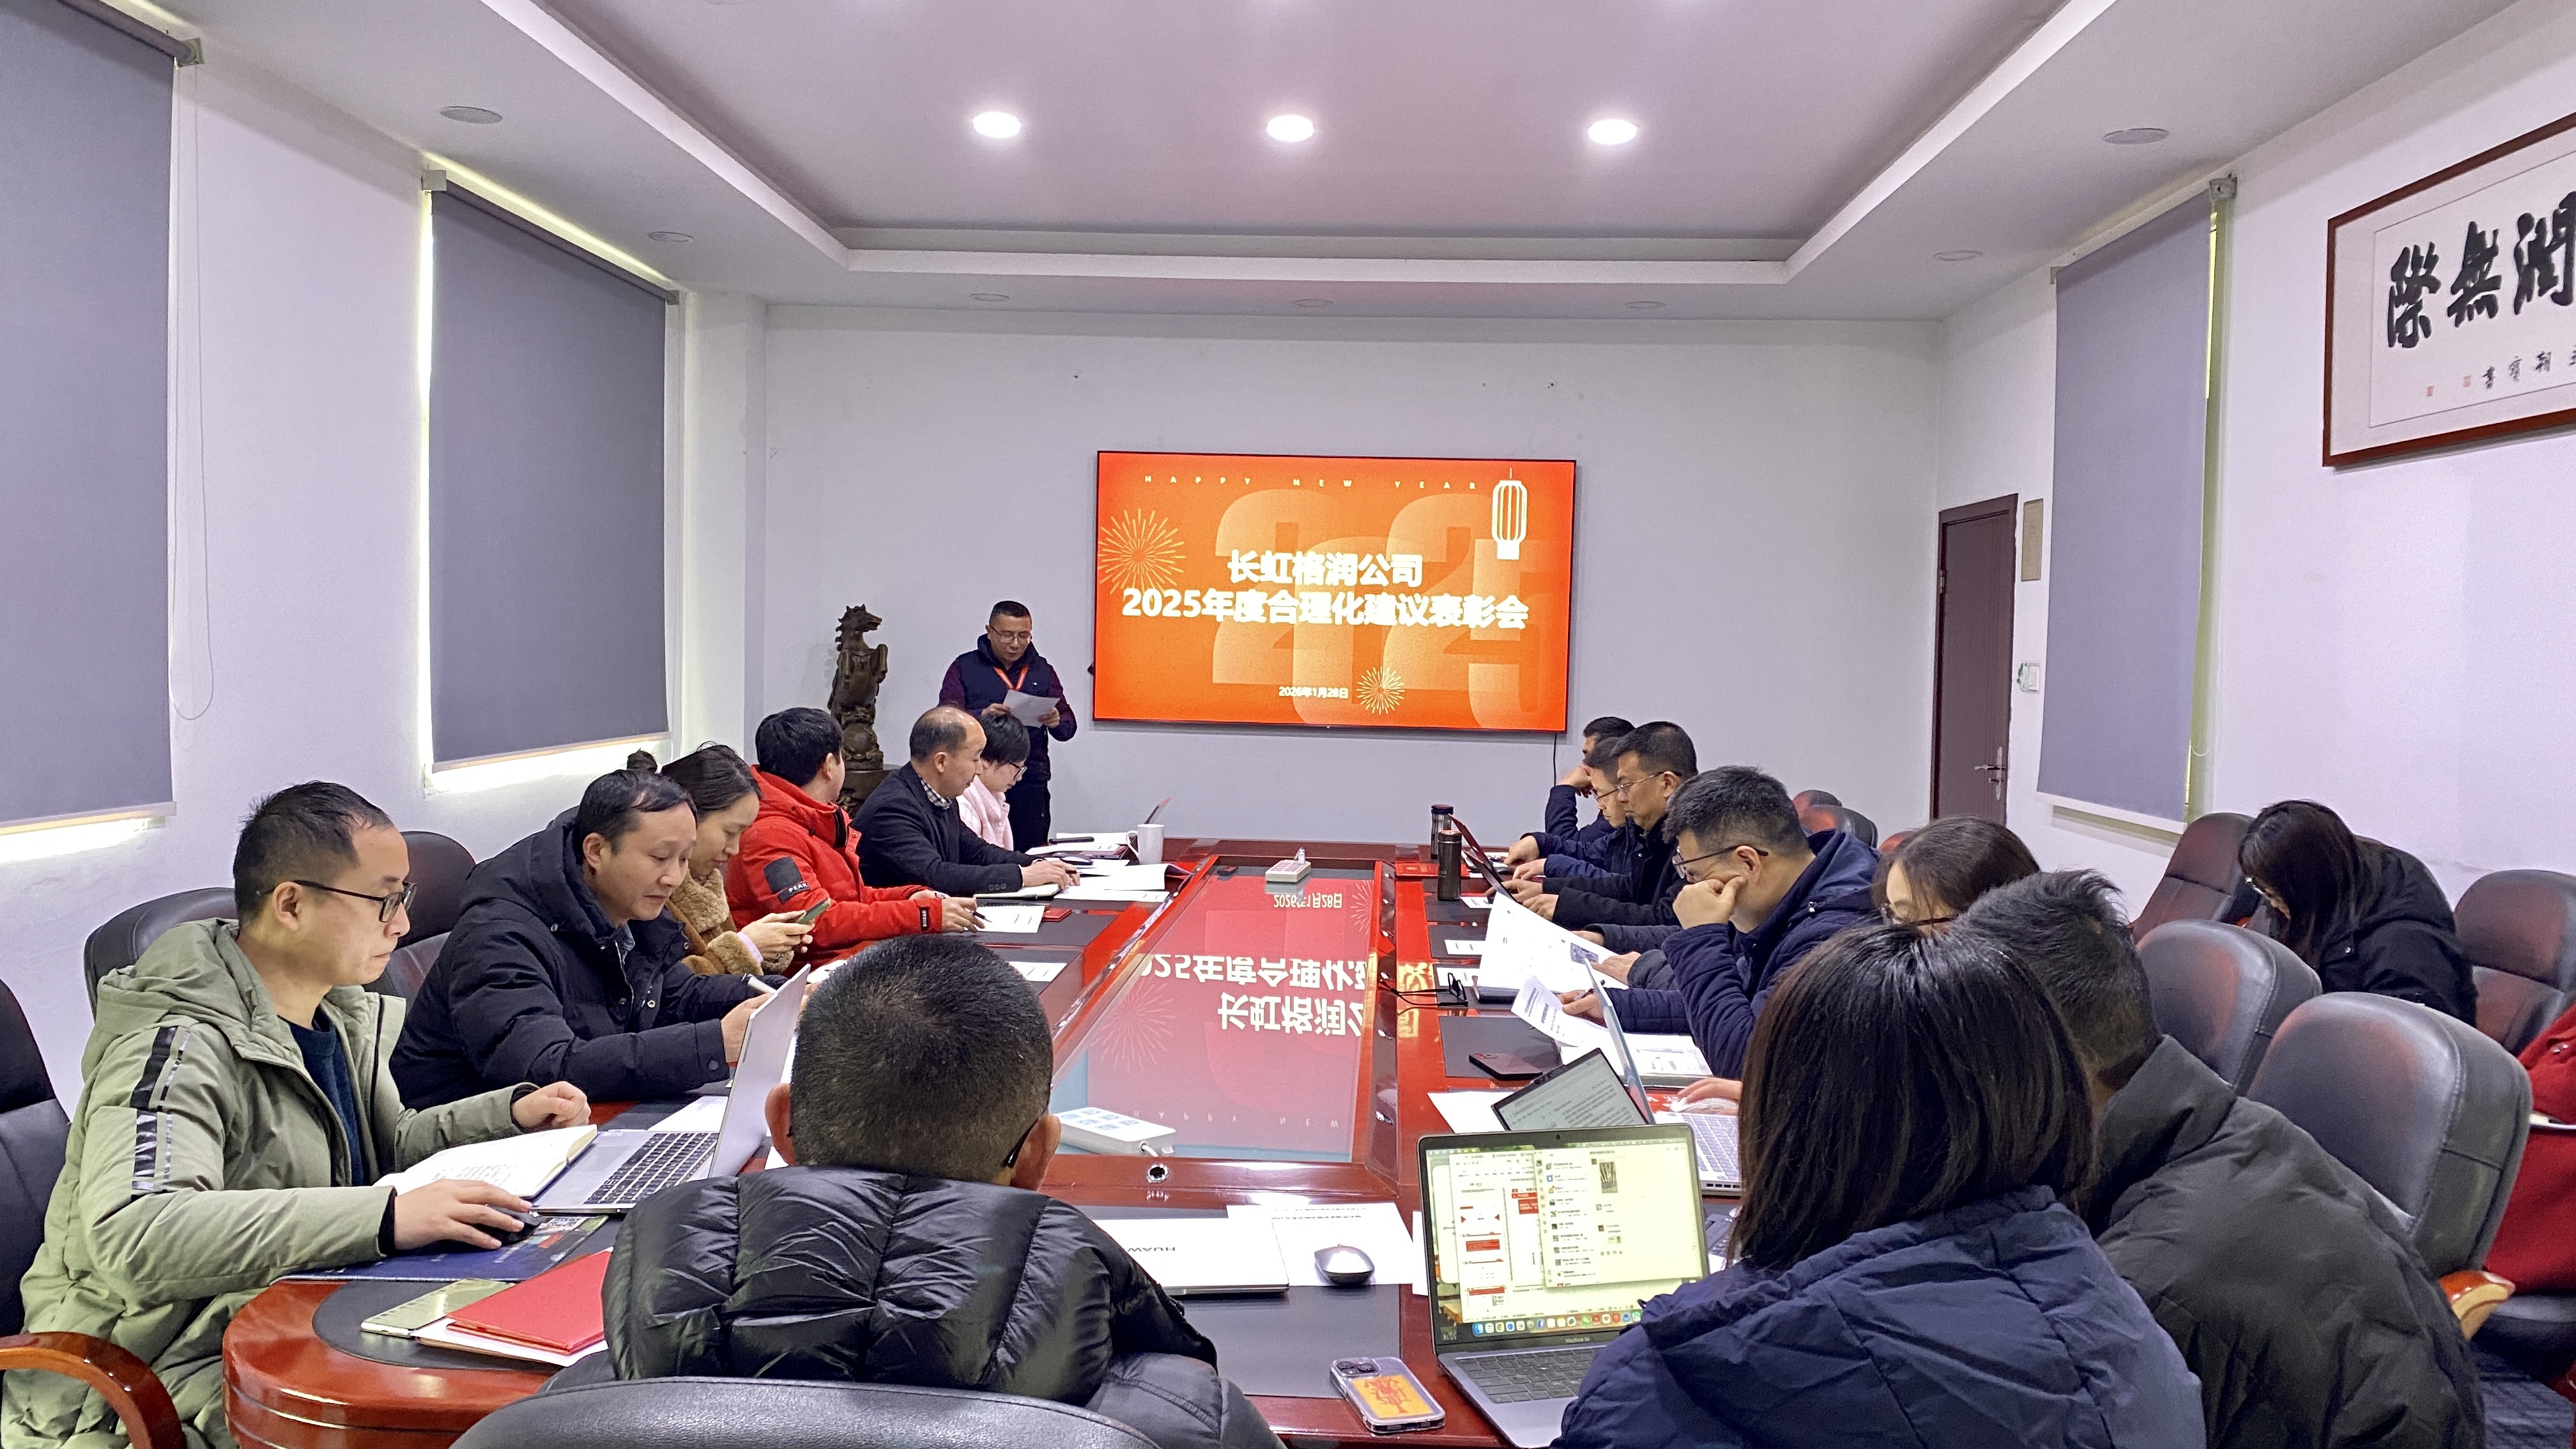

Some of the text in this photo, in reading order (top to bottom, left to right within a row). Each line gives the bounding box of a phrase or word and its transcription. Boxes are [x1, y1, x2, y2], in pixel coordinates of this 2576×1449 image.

[1145, 475, 1476, 490] HAPPY NEW YEAR
[1227, 549, 1424, 588] 长虹格润公司
[1121, 586, 1529, 630] 2025年度合理化建议表彰会
[788, 882, 808, 893] PEAK
